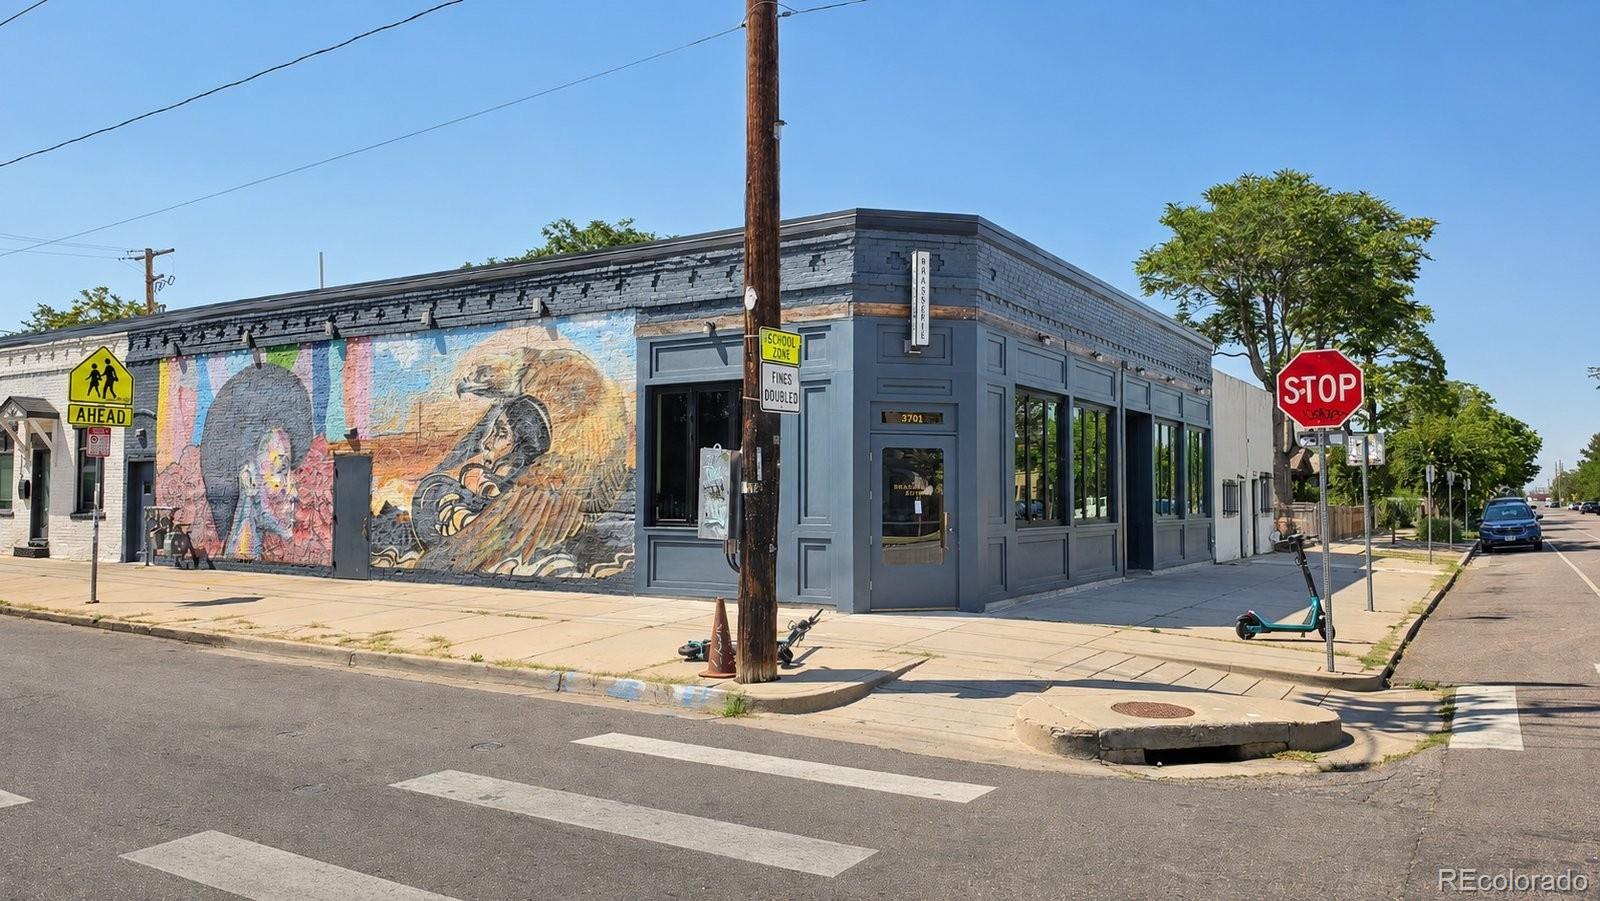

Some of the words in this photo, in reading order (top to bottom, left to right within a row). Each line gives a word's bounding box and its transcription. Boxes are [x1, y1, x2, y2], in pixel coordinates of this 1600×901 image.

[767, 333, 796, 348] SCHOOL
[772, 347, 790, 360] ZONE
[771, 371, 792, 386] FINES
[1284, 373, 1357, 404] STOP
[764, 388, 798, 405] DOUBLED
[76, 407, 126, 424] AHEAD
[901, 414, 923, 423] 3701
